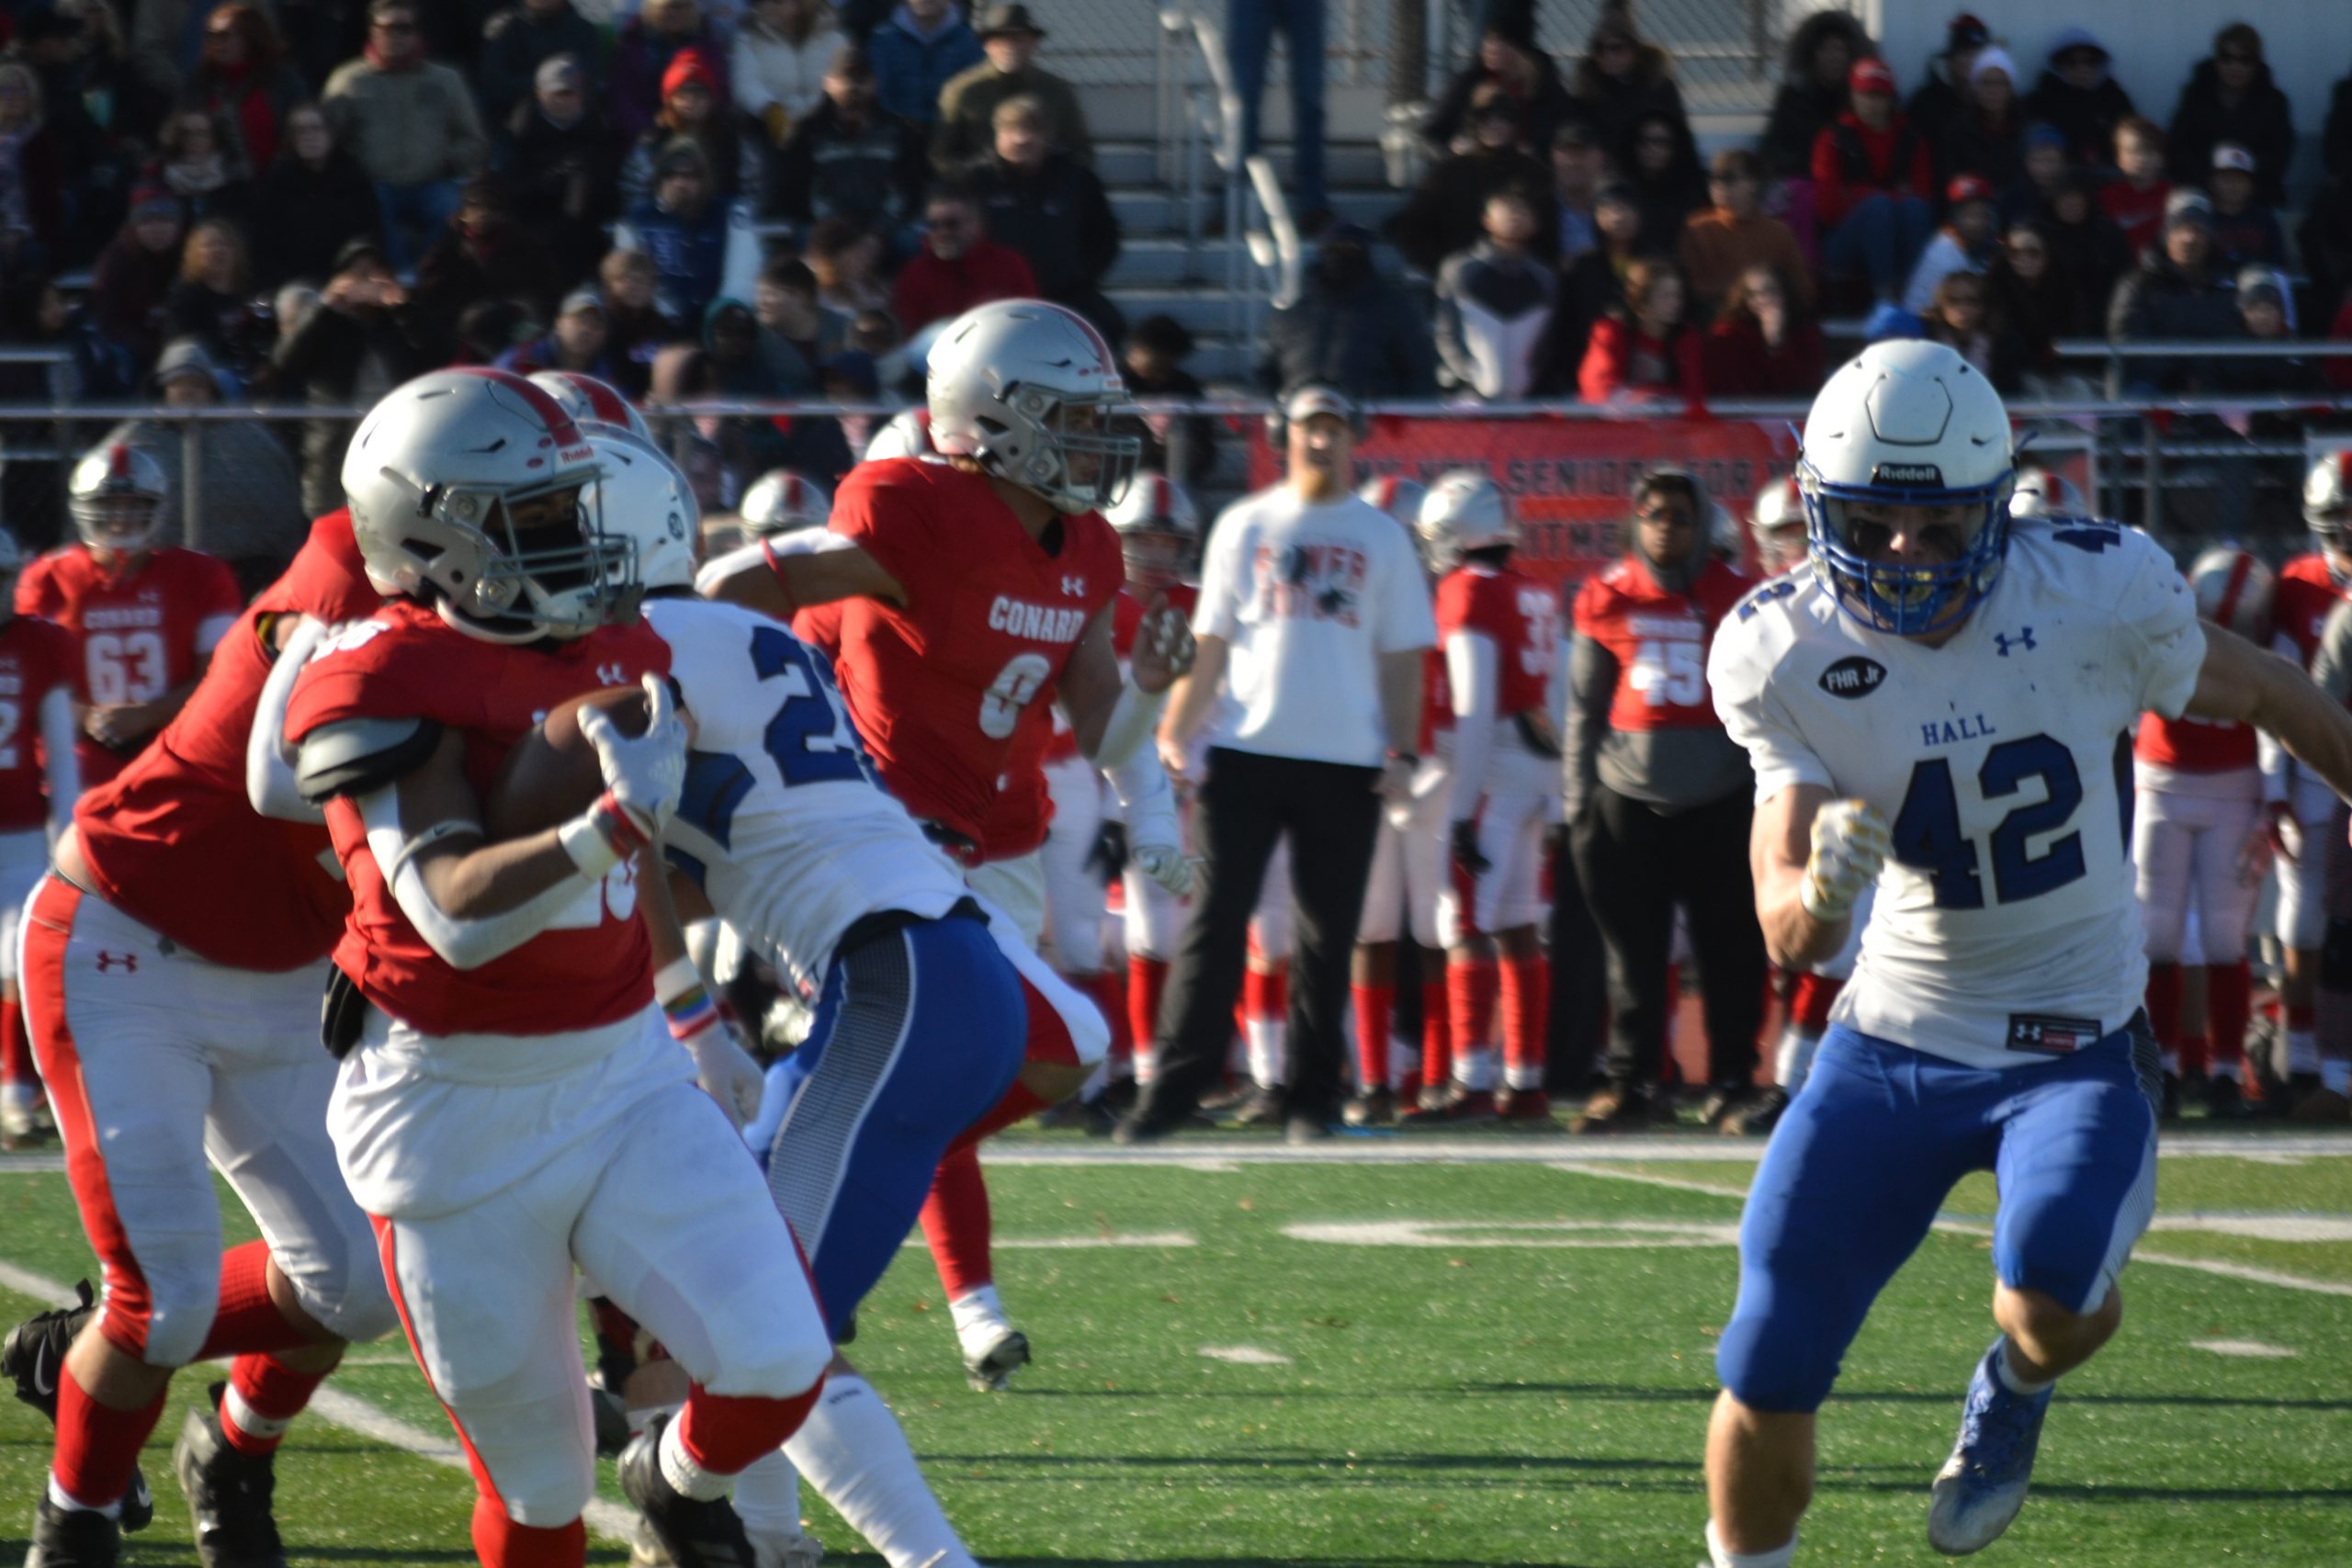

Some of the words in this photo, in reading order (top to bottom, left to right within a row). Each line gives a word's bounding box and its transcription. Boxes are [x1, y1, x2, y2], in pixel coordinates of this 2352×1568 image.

[1880, 466, 1936, 481] Riddell
[989, 595, 1085, 643] CONARD
[86, 632, 165, 705] 63
[1632, 639, 1703, 705] 45
[1826, 669, 1860, 691] FHR
[1920, 715, 1996, 746] HALL
[1891, 732, 2086, 910] 42
